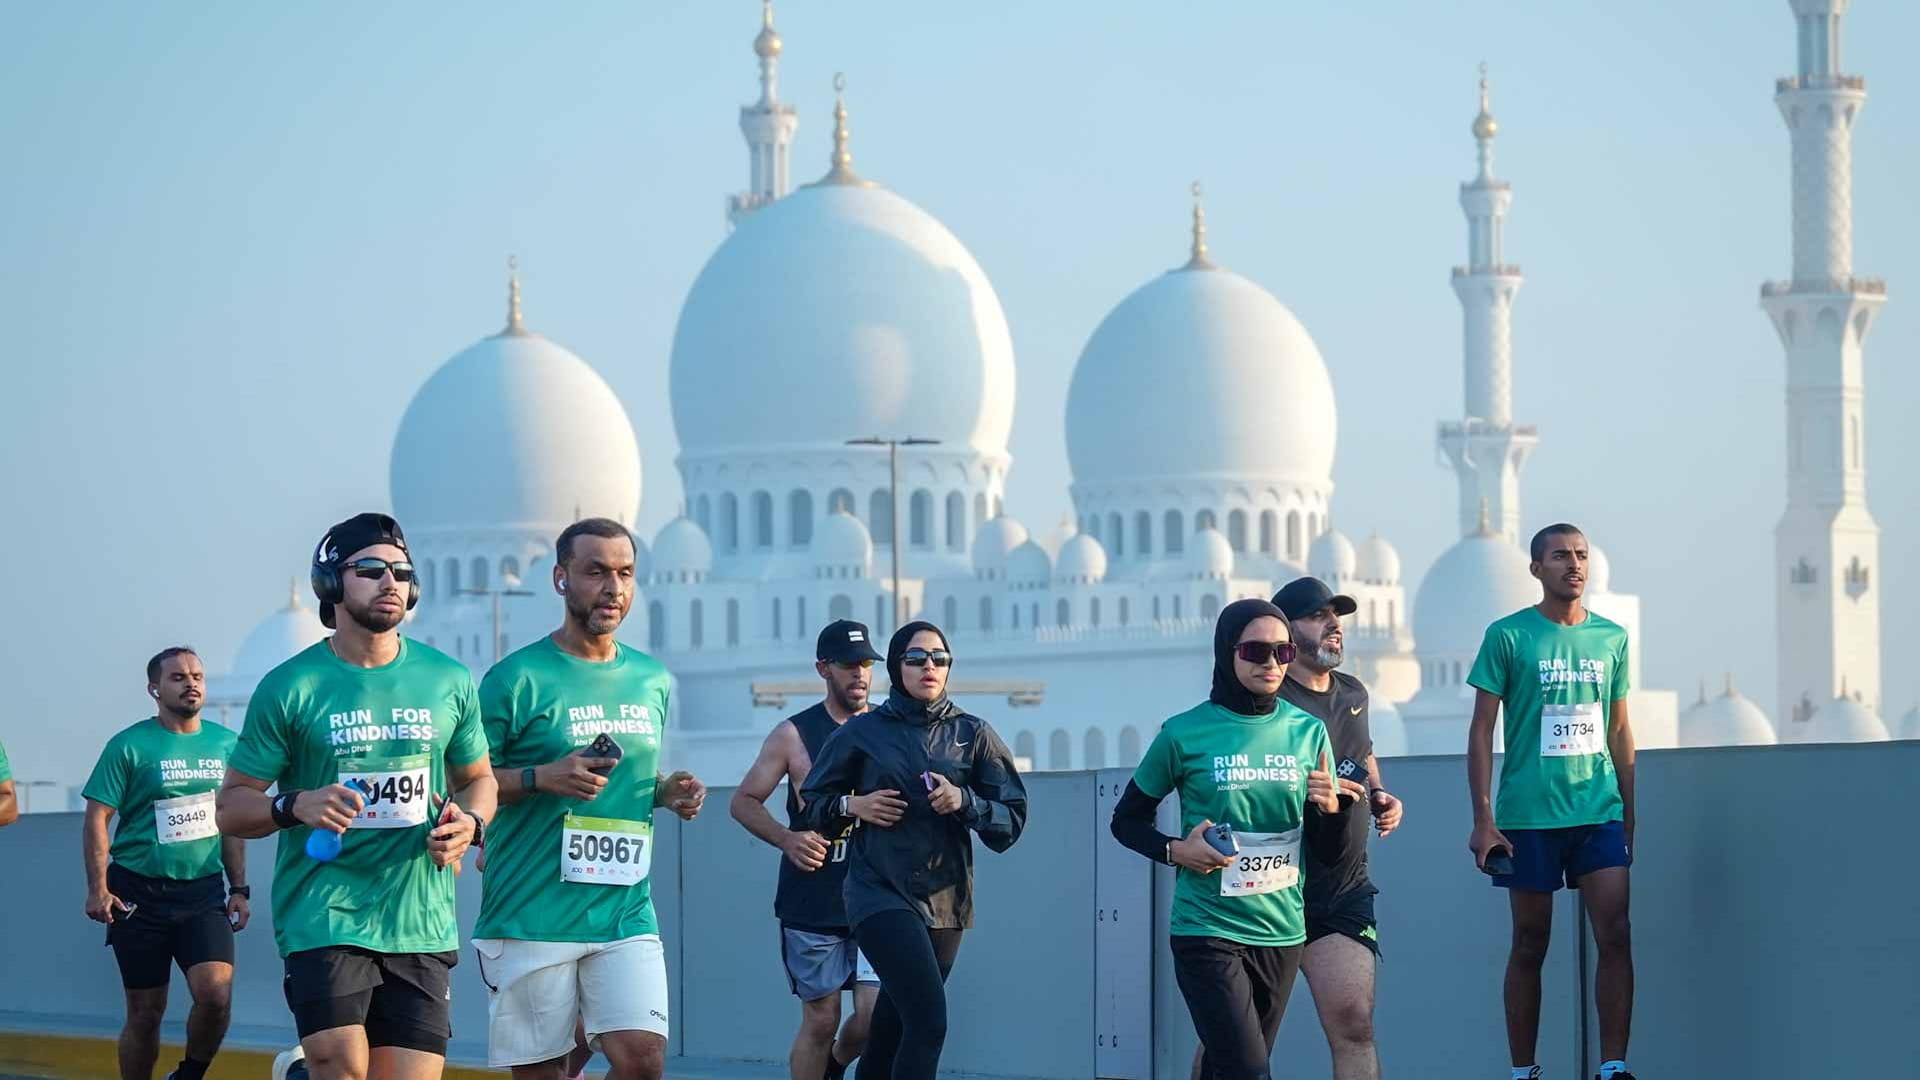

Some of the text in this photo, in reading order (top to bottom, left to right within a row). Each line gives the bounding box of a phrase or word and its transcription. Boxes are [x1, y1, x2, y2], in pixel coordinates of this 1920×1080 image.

[1539, 659, 1604, 673] RUN FOR
[1540, 670, 1604, 684] KINDNESS
[329, 708, 432, 728] RUN FOR
[568, 704, 650, 720] RUN FOR
[331, 725, 433, 746] KINDNESS
[571, 720, 655, 737] KINDNESS
[1553, 723, 1594, 737] 31734
[160, 759, 223, 770] RUN FOR
[1214, 754, 1297, 769] RUN FOR
[161, 769, 225, 781] KINDNESS
[1215, 768, 1299, 783] KINDNESS
[168, 809, 206, 826] 33449
[568, 834, 644, 864] 50967
[1239, 853, 1290, 872] 33764
